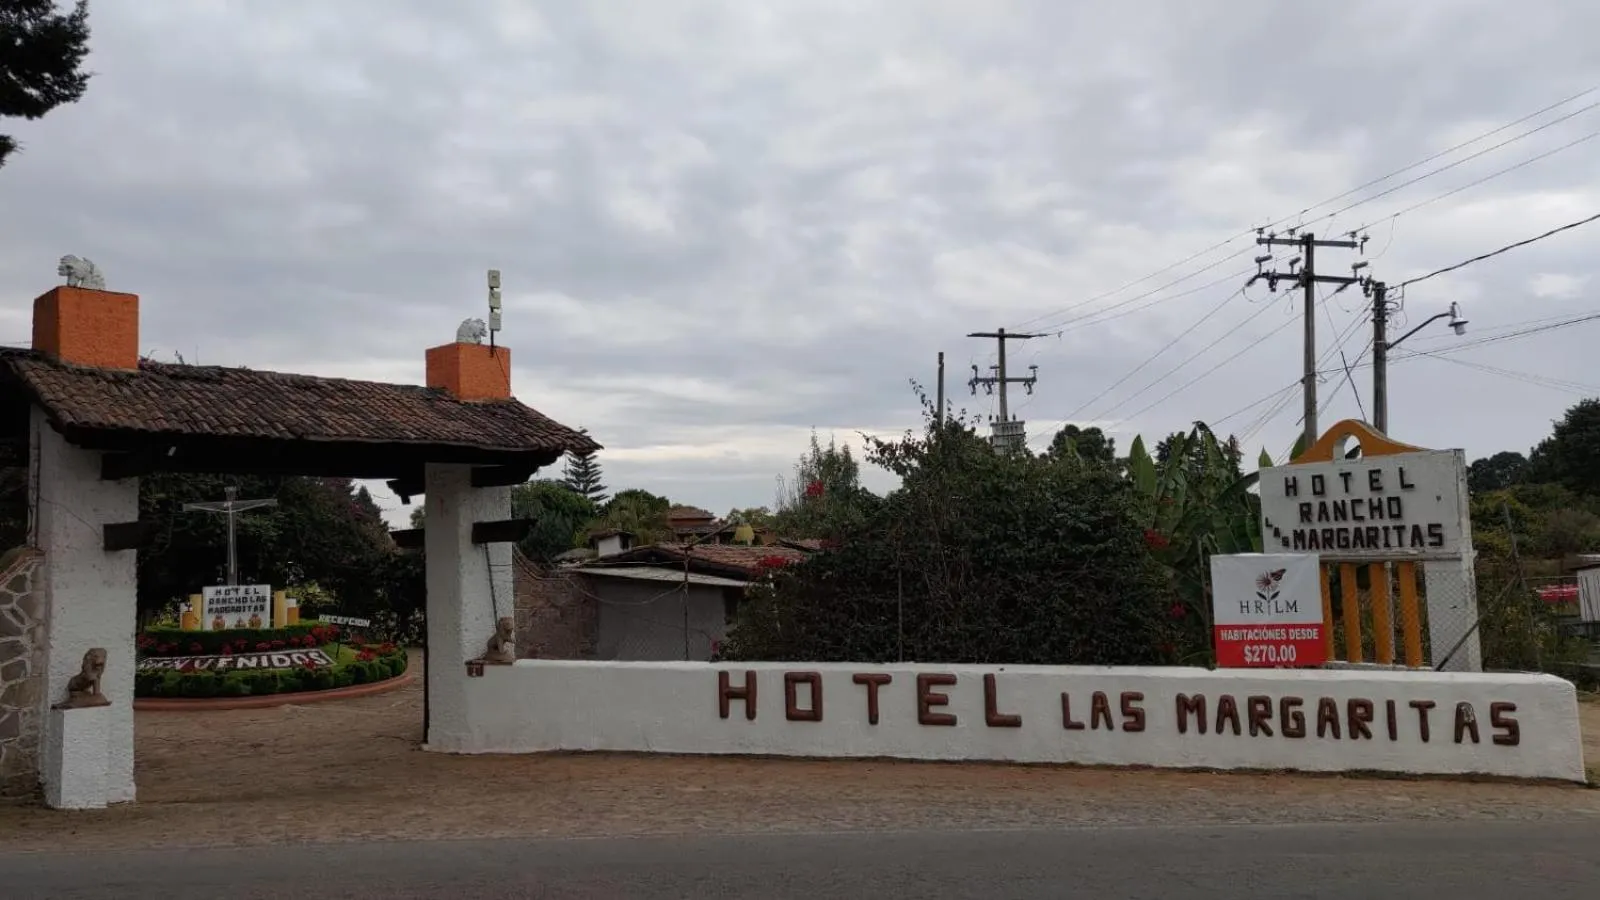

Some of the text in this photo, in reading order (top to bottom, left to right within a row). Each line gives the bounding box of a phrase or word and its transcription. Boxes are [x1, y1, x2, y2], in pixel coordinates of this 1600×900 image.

[1284, 467, 1415, 496] HOTEL
[1299, 496, 1403, 523] RANCHO
[1265, 517, 1290, 548] LAS
[1293, 523, 1443, 550] MARGARITAS
[215, 587, 260, 596] HOTEL
[1289, 628, 1319, 640] DESDE
[1244, 644, 1297, 664] $270.00
[718, 670, 1521, 746] HOTEL LAS MARGARITAS
